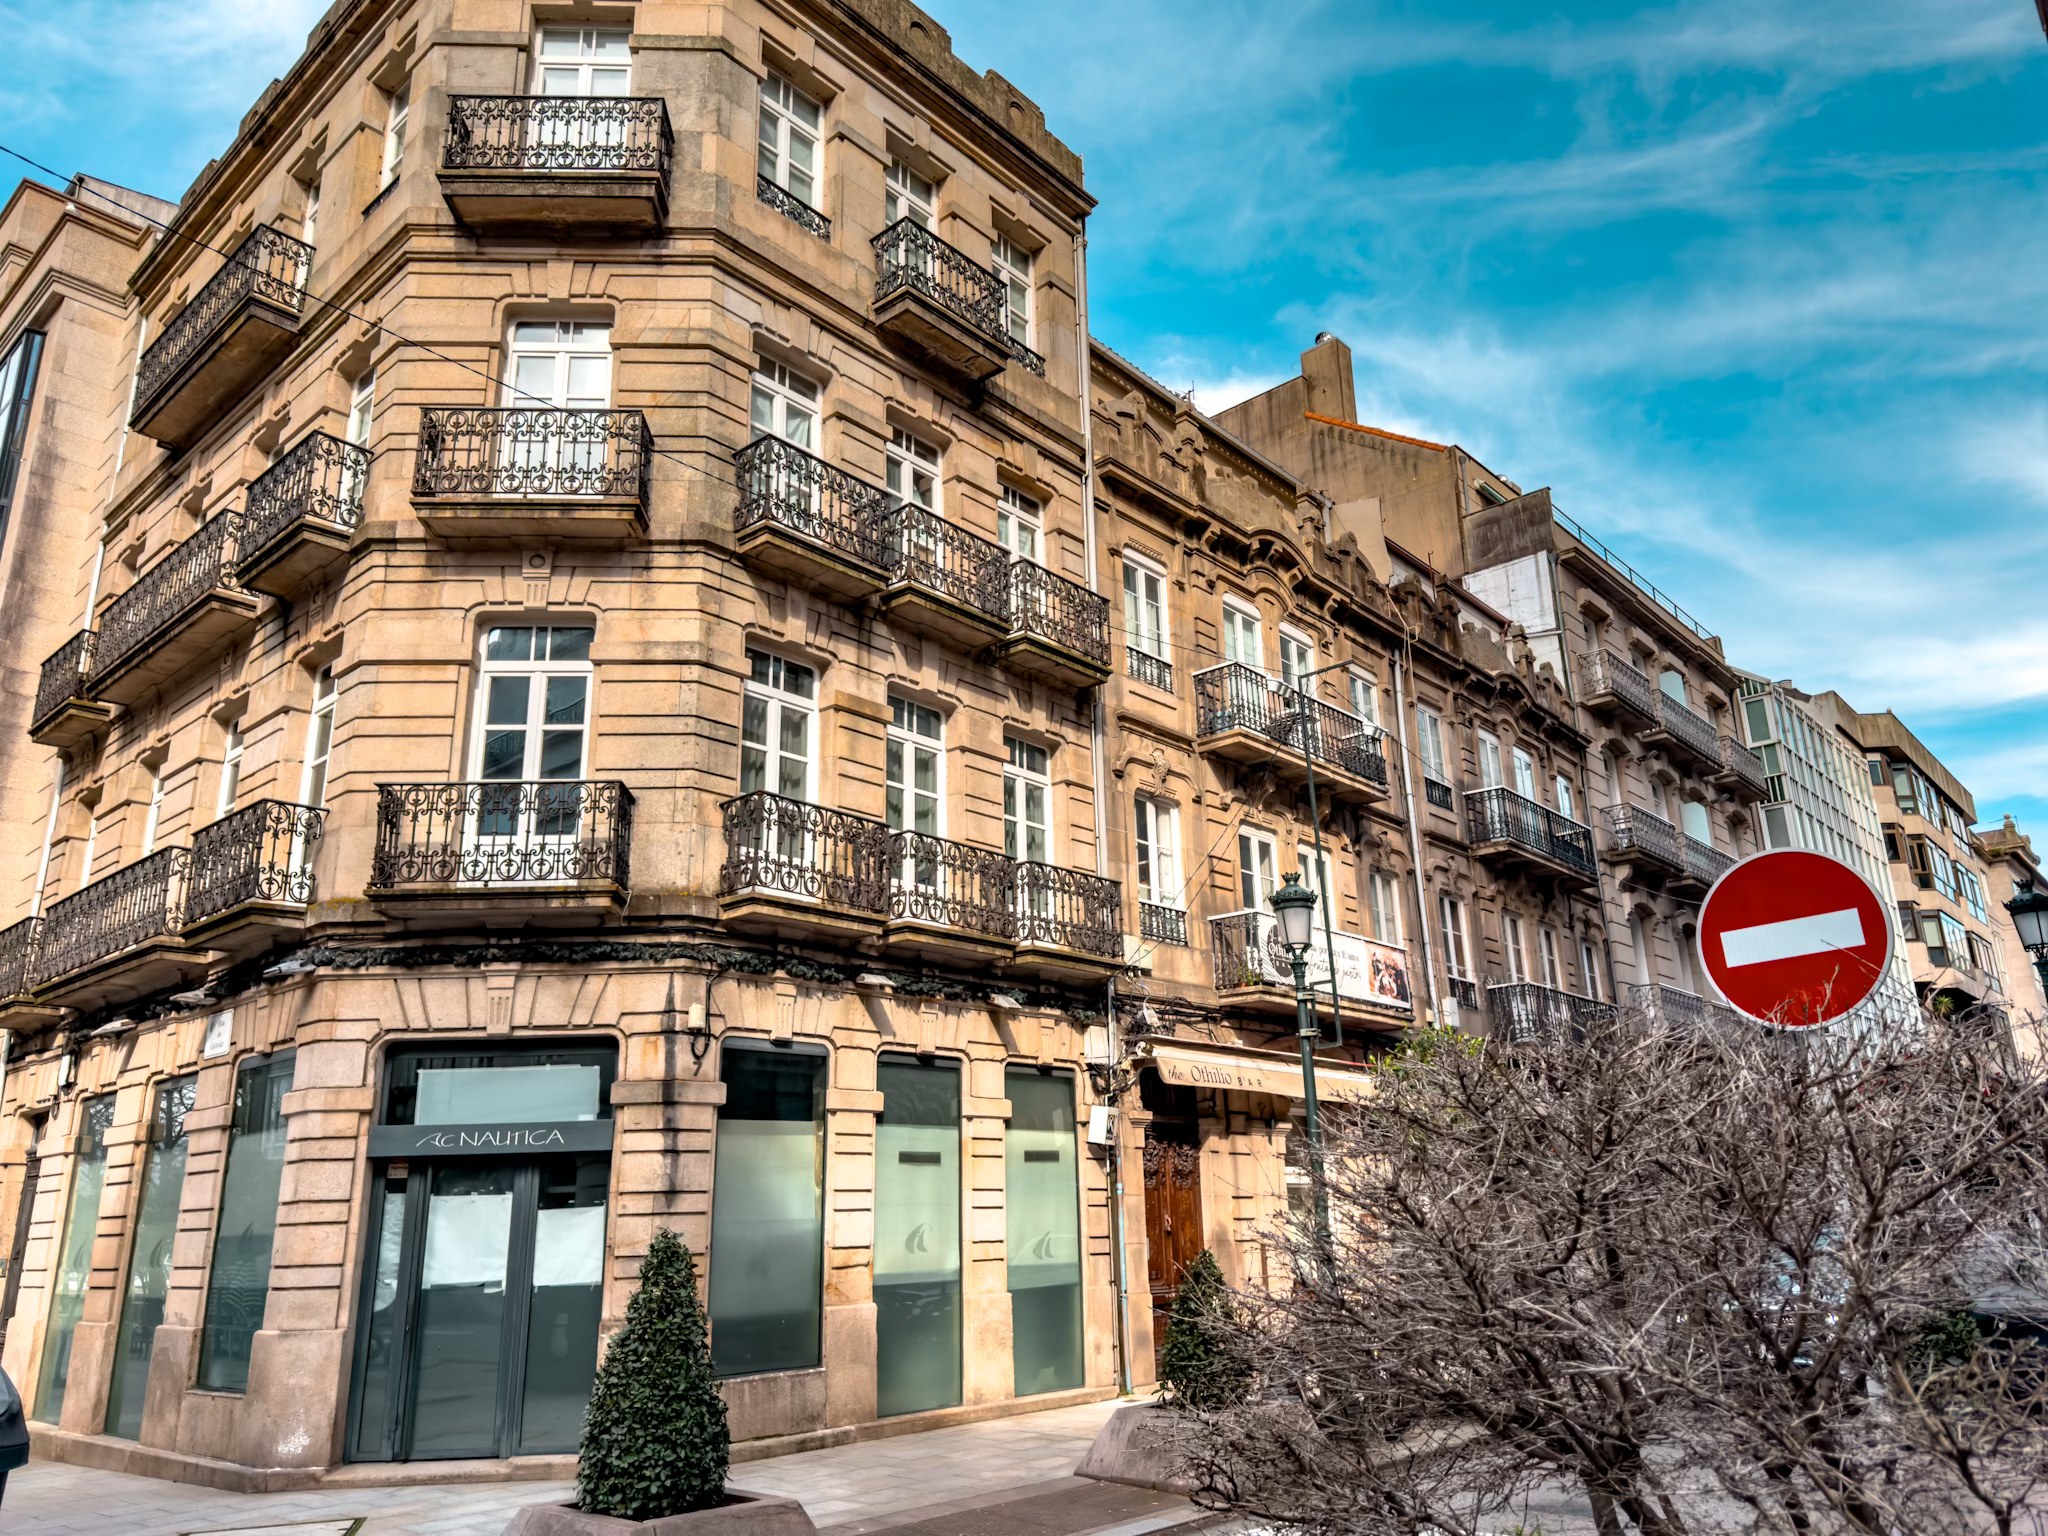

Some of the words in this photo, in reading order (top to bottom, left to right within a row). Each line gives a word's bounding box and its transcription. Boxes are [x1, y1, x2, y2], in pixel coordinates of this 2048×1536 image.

[1168, 1065, 1184, 1081] the
[1190, 1065, 1233, 1085] Othilio
[460, 1129, 565, 1147] NAUTICA
